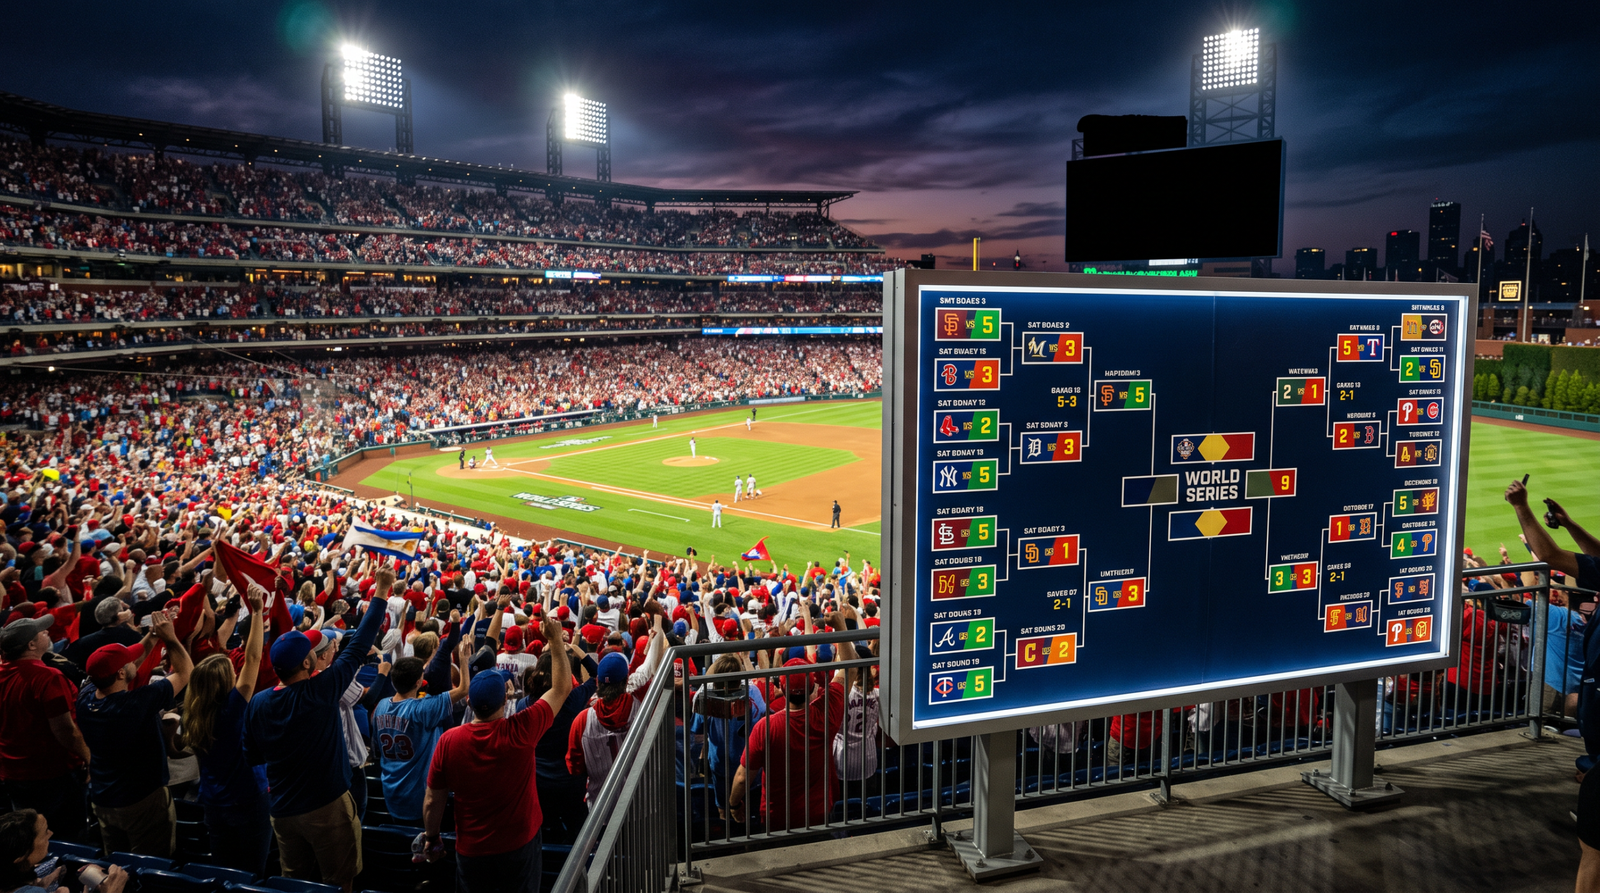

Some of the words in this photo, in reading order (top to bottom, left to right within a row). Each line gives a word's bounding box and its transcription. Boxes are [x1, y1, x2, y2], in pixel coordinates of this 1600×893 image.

[983, 316, 993, 333] 5
[1065, 340, 1075, 356] 3
[1344, 340, 1351, 355] 5
[1367, 339, 1380, 357] T
[982, 366, 992, 383] 3
[1406, 362, 1413, 376] 2
[1430, 359, 1441, 378] SD
[1136, 387, 1144, 402] 5
[1284, 385, 1291, 399] 2
[1311, 384, 1317, 398] 1
[1340, 390, 1354, 400] 2-1
[1057, 396, 1077, 407] 5-3
[1402, 402, 1413, 421] P
[981, 417, 991, 434] 2
[1340, 429, 1347, 443] 2
[1364, 426, 1374, 443] B
[1064, 439, 1073, 454] 3
[980, 467, 989, 482] 5
[1185, 469, 1240, 485] WORLD
[1281, 475, 1289, 490] 9
[1187, 485, 1238, 502] SERIES
[1399, 496, 1407, 510] 5
[979, 524, 988, 540] 5
[1337, 521, 1342, 535] 1
[1397, 538, 1405, 552] 4
[1422, 534, 1432, 552] P
[1025, 543, 1039, 563] SD
[1063, 543, 1068, 559] 1
[978, 573, 987, 590] 3
[1275, 571, 1283, 586] 3
[1303, 569, 1311, 584] 3
[1330, 572, 1345, 582] 2-1
[1095, 587, 1108, 605] SD
[1128, 585, 1138, 601] 3
[1054, 598, 1071, 610] 2-1
[935, 626, 955, 648] A
[976, 626, 985, 642] 2
[1392, 623, 1403, 642] P
[1025, 643, 1036, 662] C
[1059, 641, 1068, 658] 2
[974, 675, 984, 692] 5
[380, 733, 414, 761] 23
